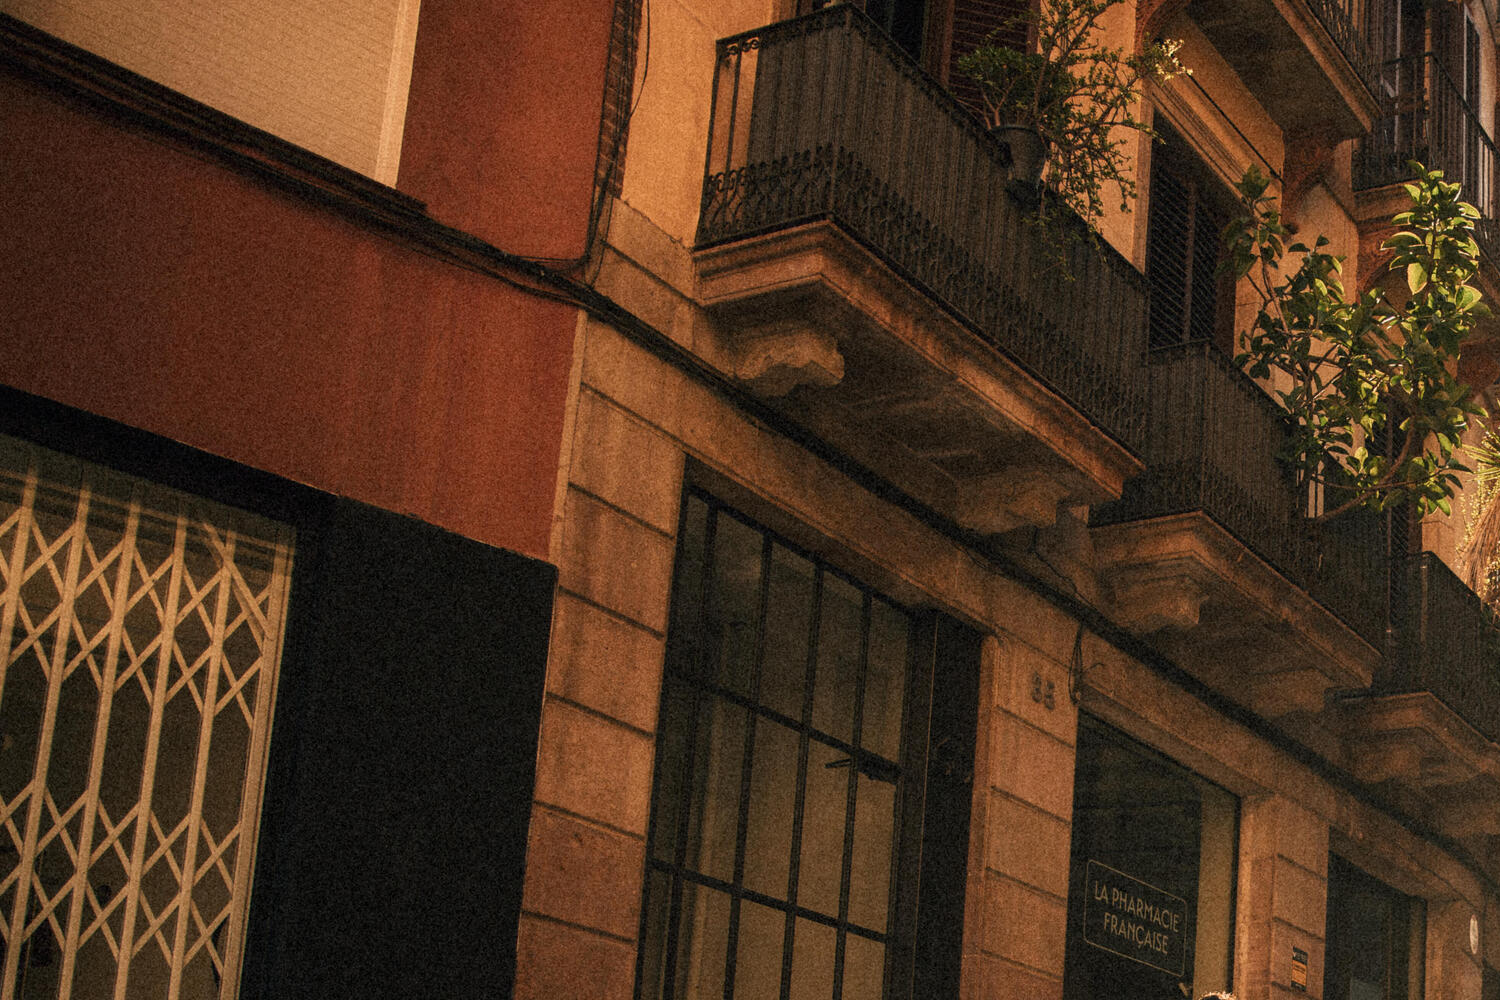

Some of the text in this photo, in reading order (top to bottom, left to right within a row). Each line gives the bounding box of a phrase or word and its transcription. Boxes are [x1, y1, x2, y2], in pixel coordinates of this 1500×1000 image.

[1094, 880, 1180, 933] LA PHARMACIE
[1103, 911, 1169, 955] FRANÇAISE
